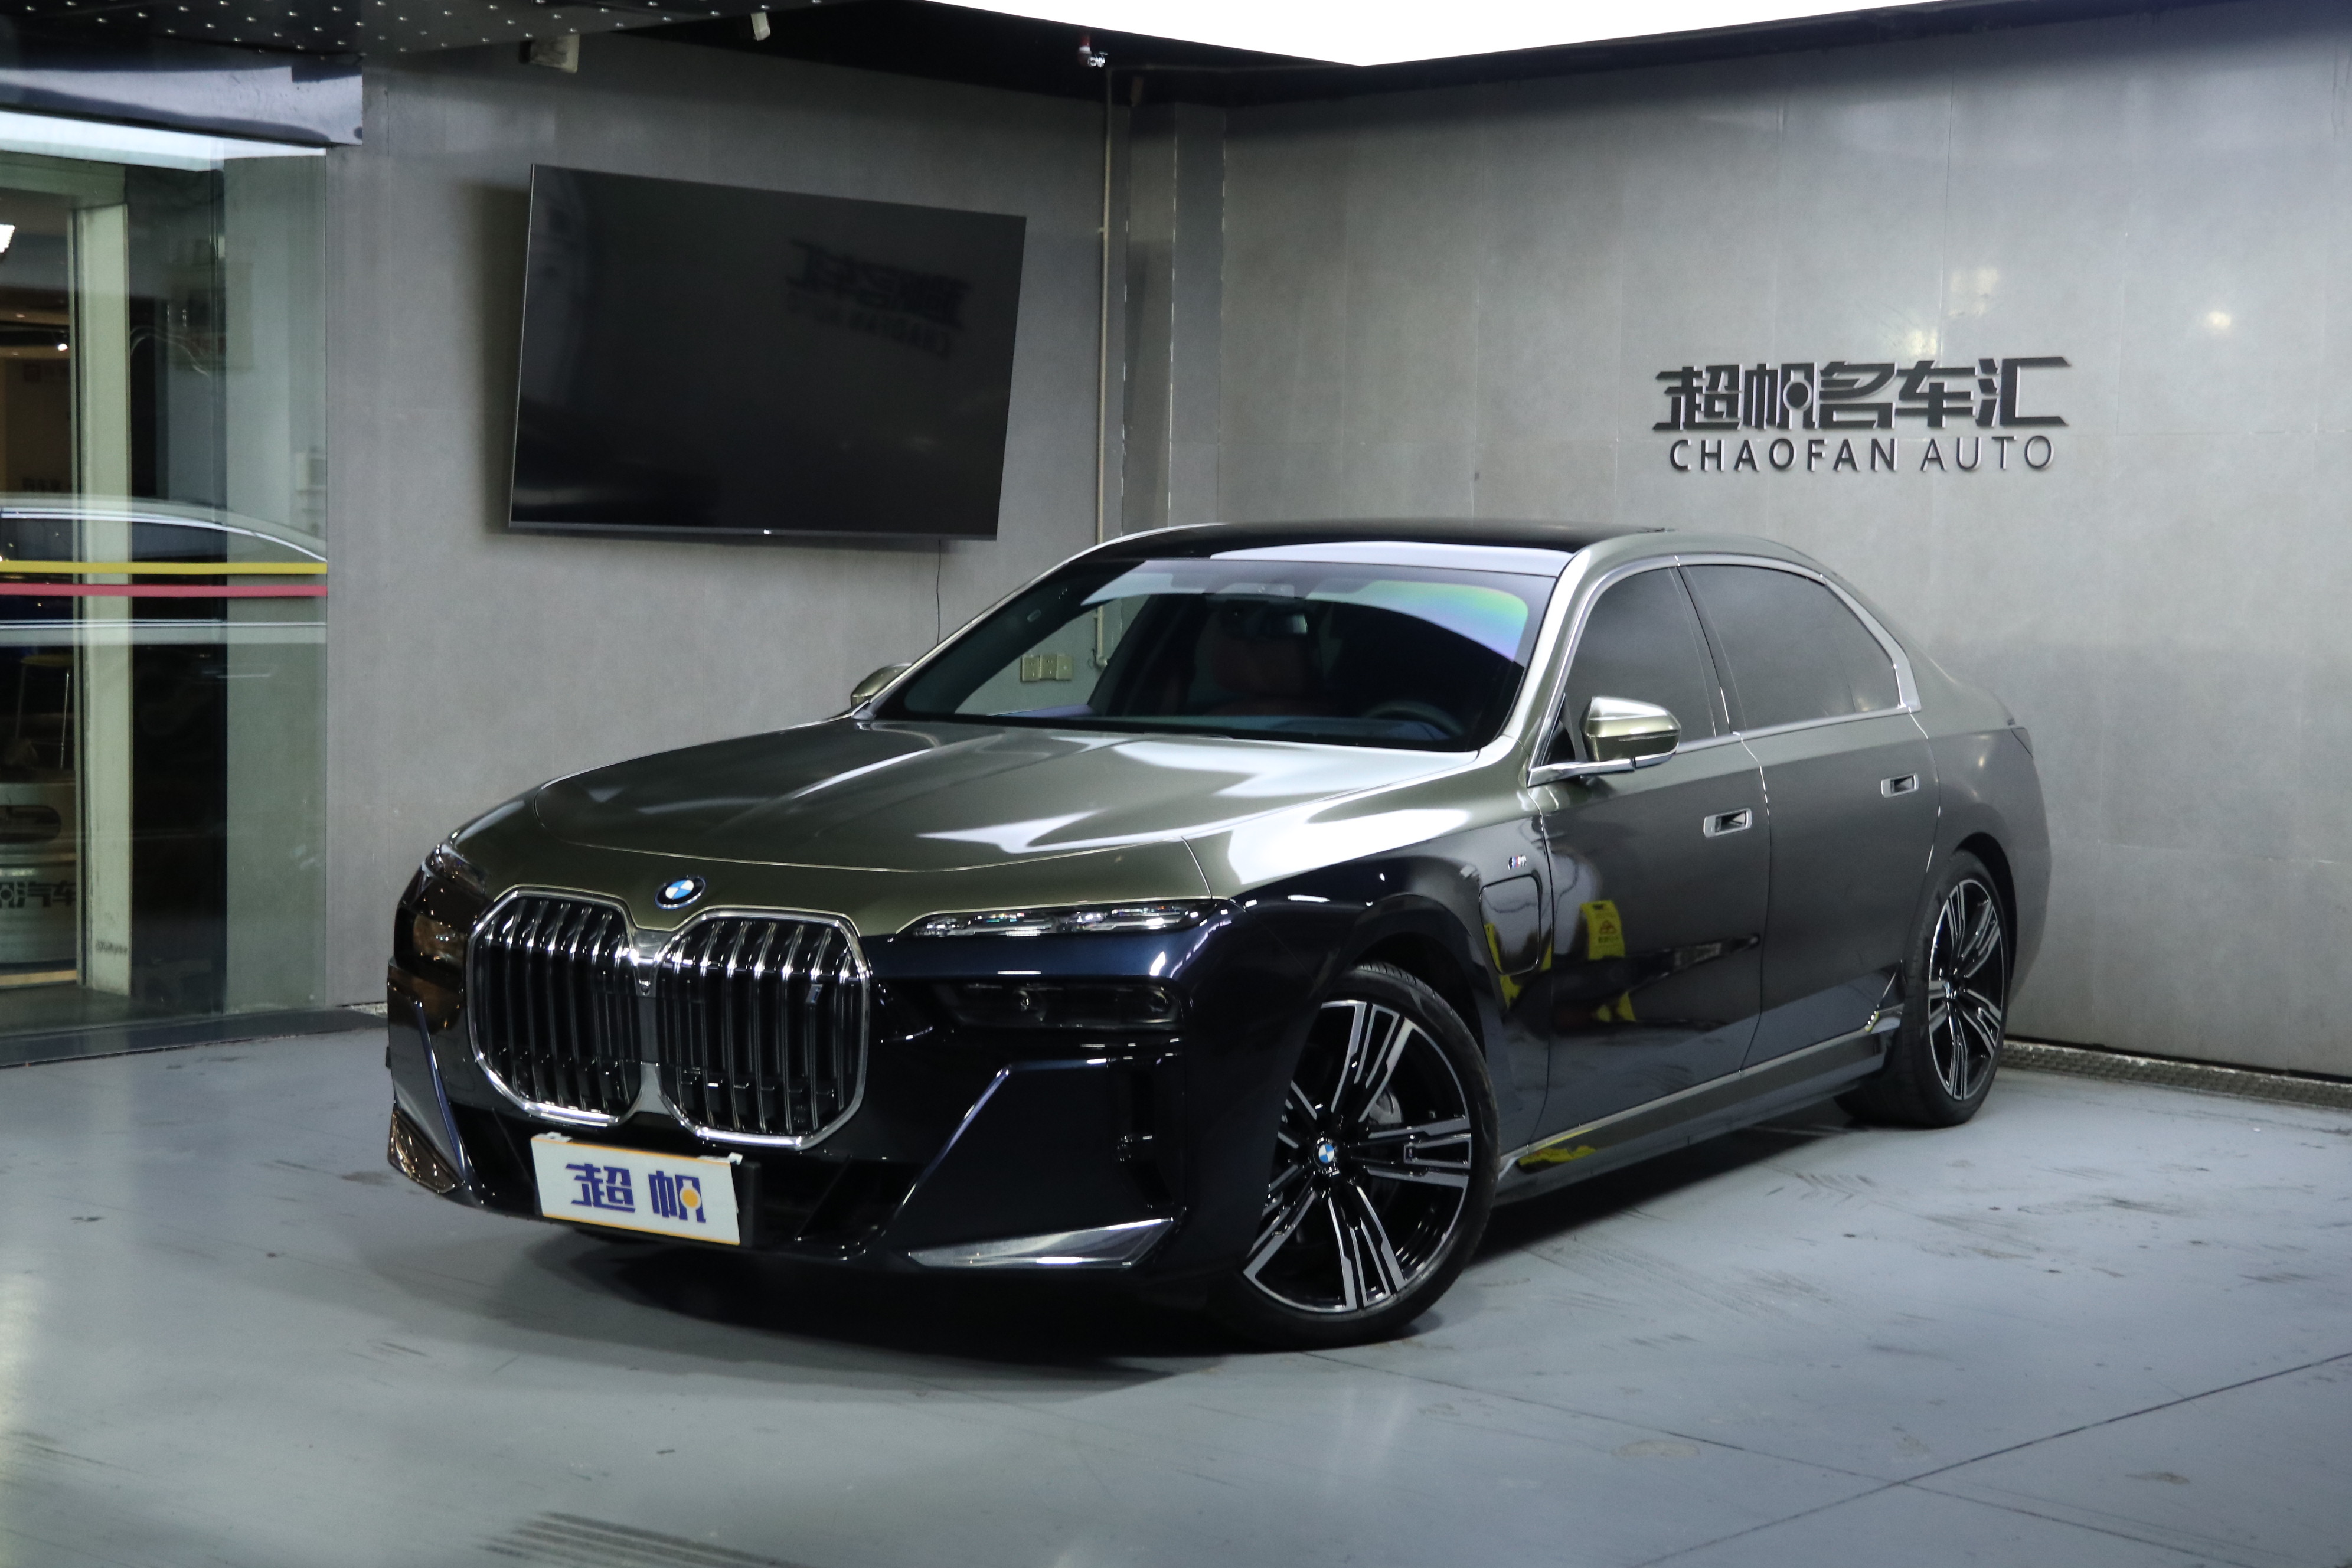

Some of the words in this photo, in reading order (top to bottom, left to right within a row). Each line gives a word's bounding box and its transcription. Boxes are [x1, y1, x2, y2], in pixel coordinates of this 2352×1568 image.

[1653, 357, 2070, 430] 超帆名车汇
[1670, 438, 1897, 471] CHAOFAN
[1920, 435, 2054, 471] AUTO
[565, 1163, 707, 1223] 超帆
